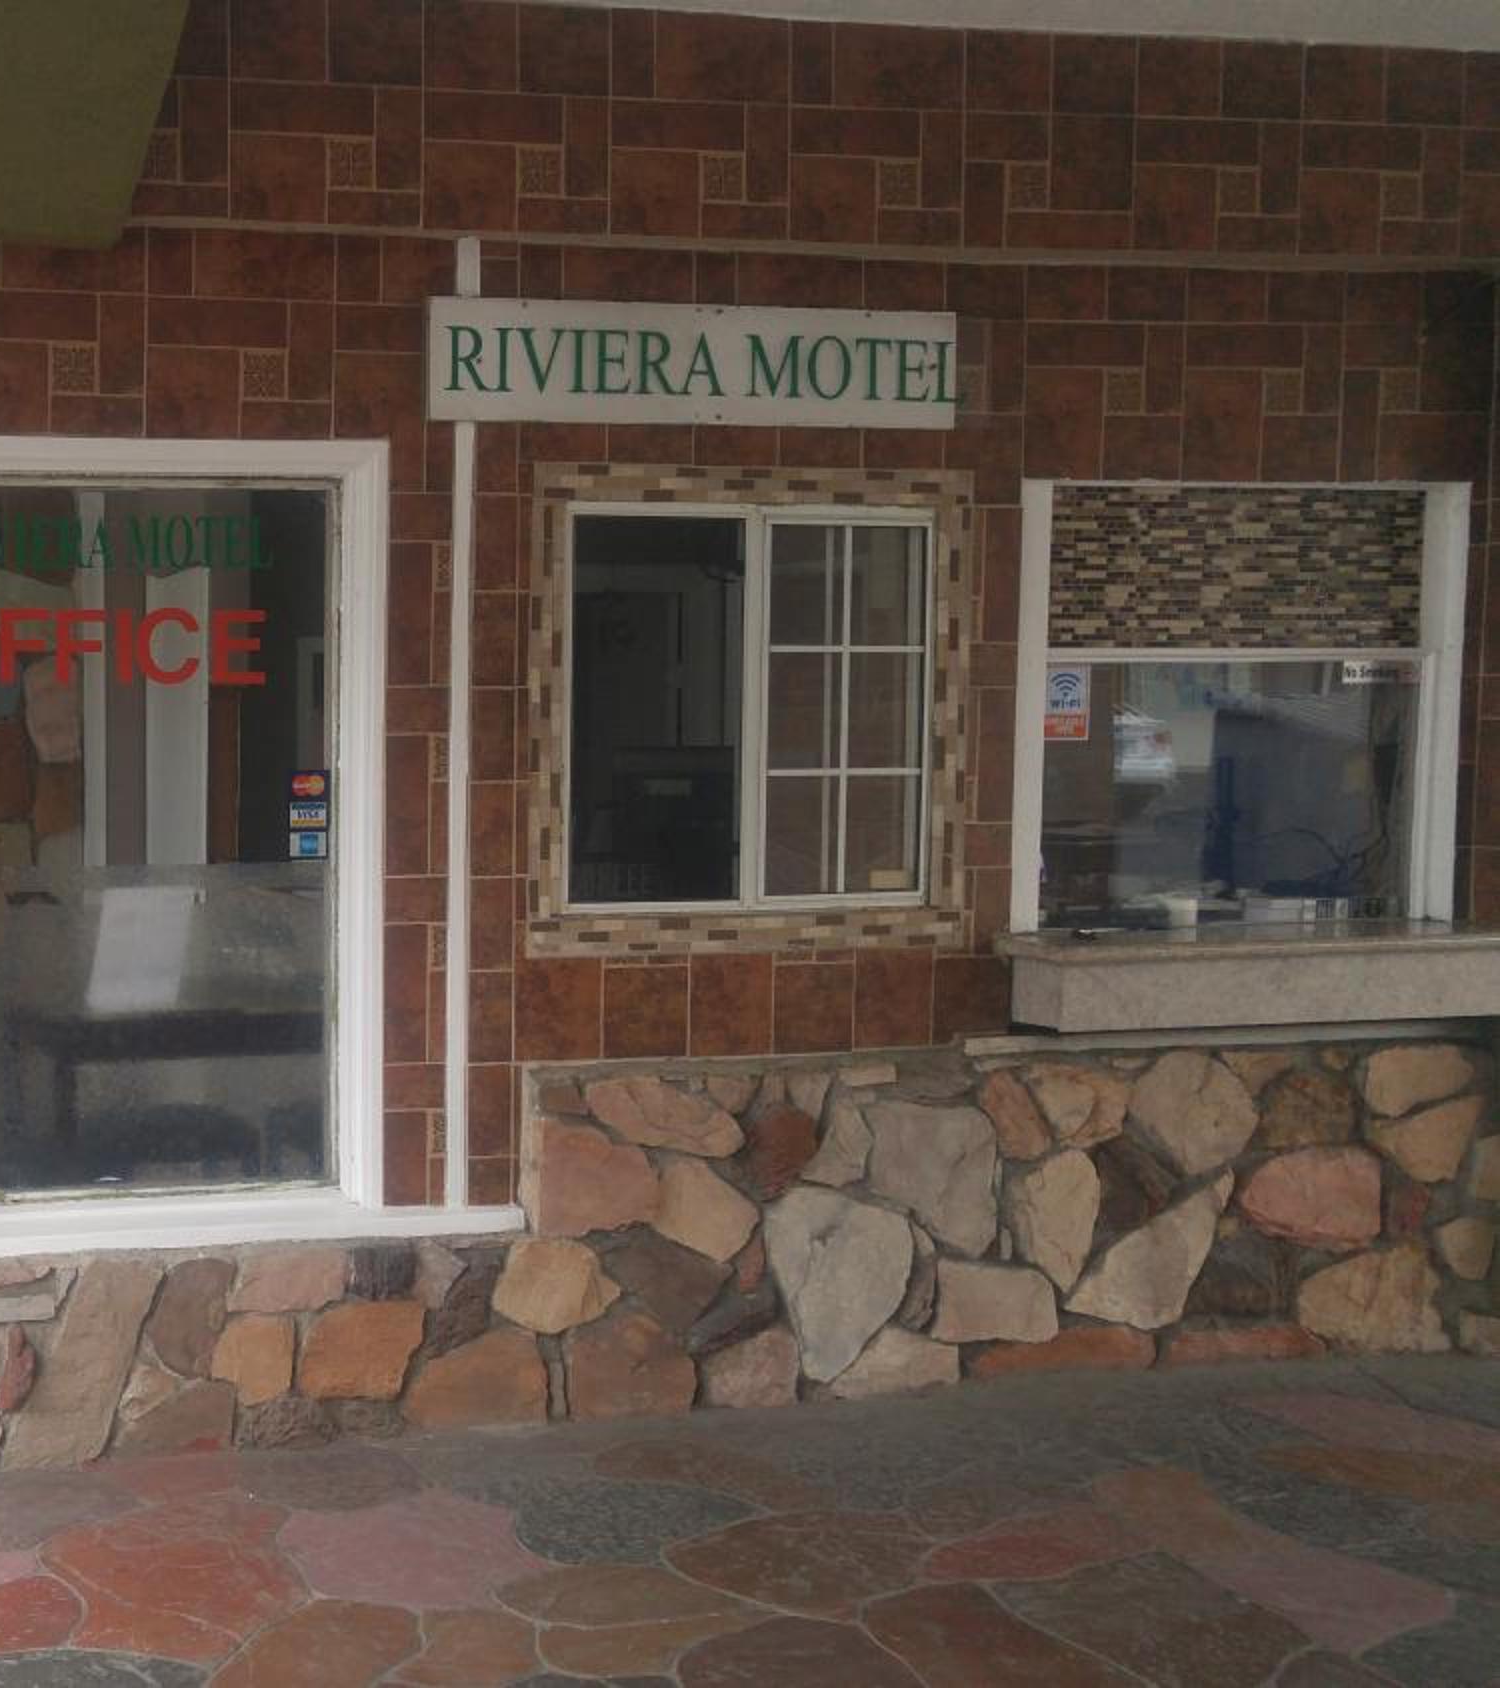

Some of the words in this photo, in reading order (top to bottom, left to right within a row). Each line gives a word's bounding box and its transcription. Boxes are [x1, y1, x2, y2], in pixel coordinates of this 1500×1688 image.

[443, 324, 725, 397] RIVIERA
[745, 333, 965, 405] MOTEL
[129, 512, 274, 573] MOTEL
